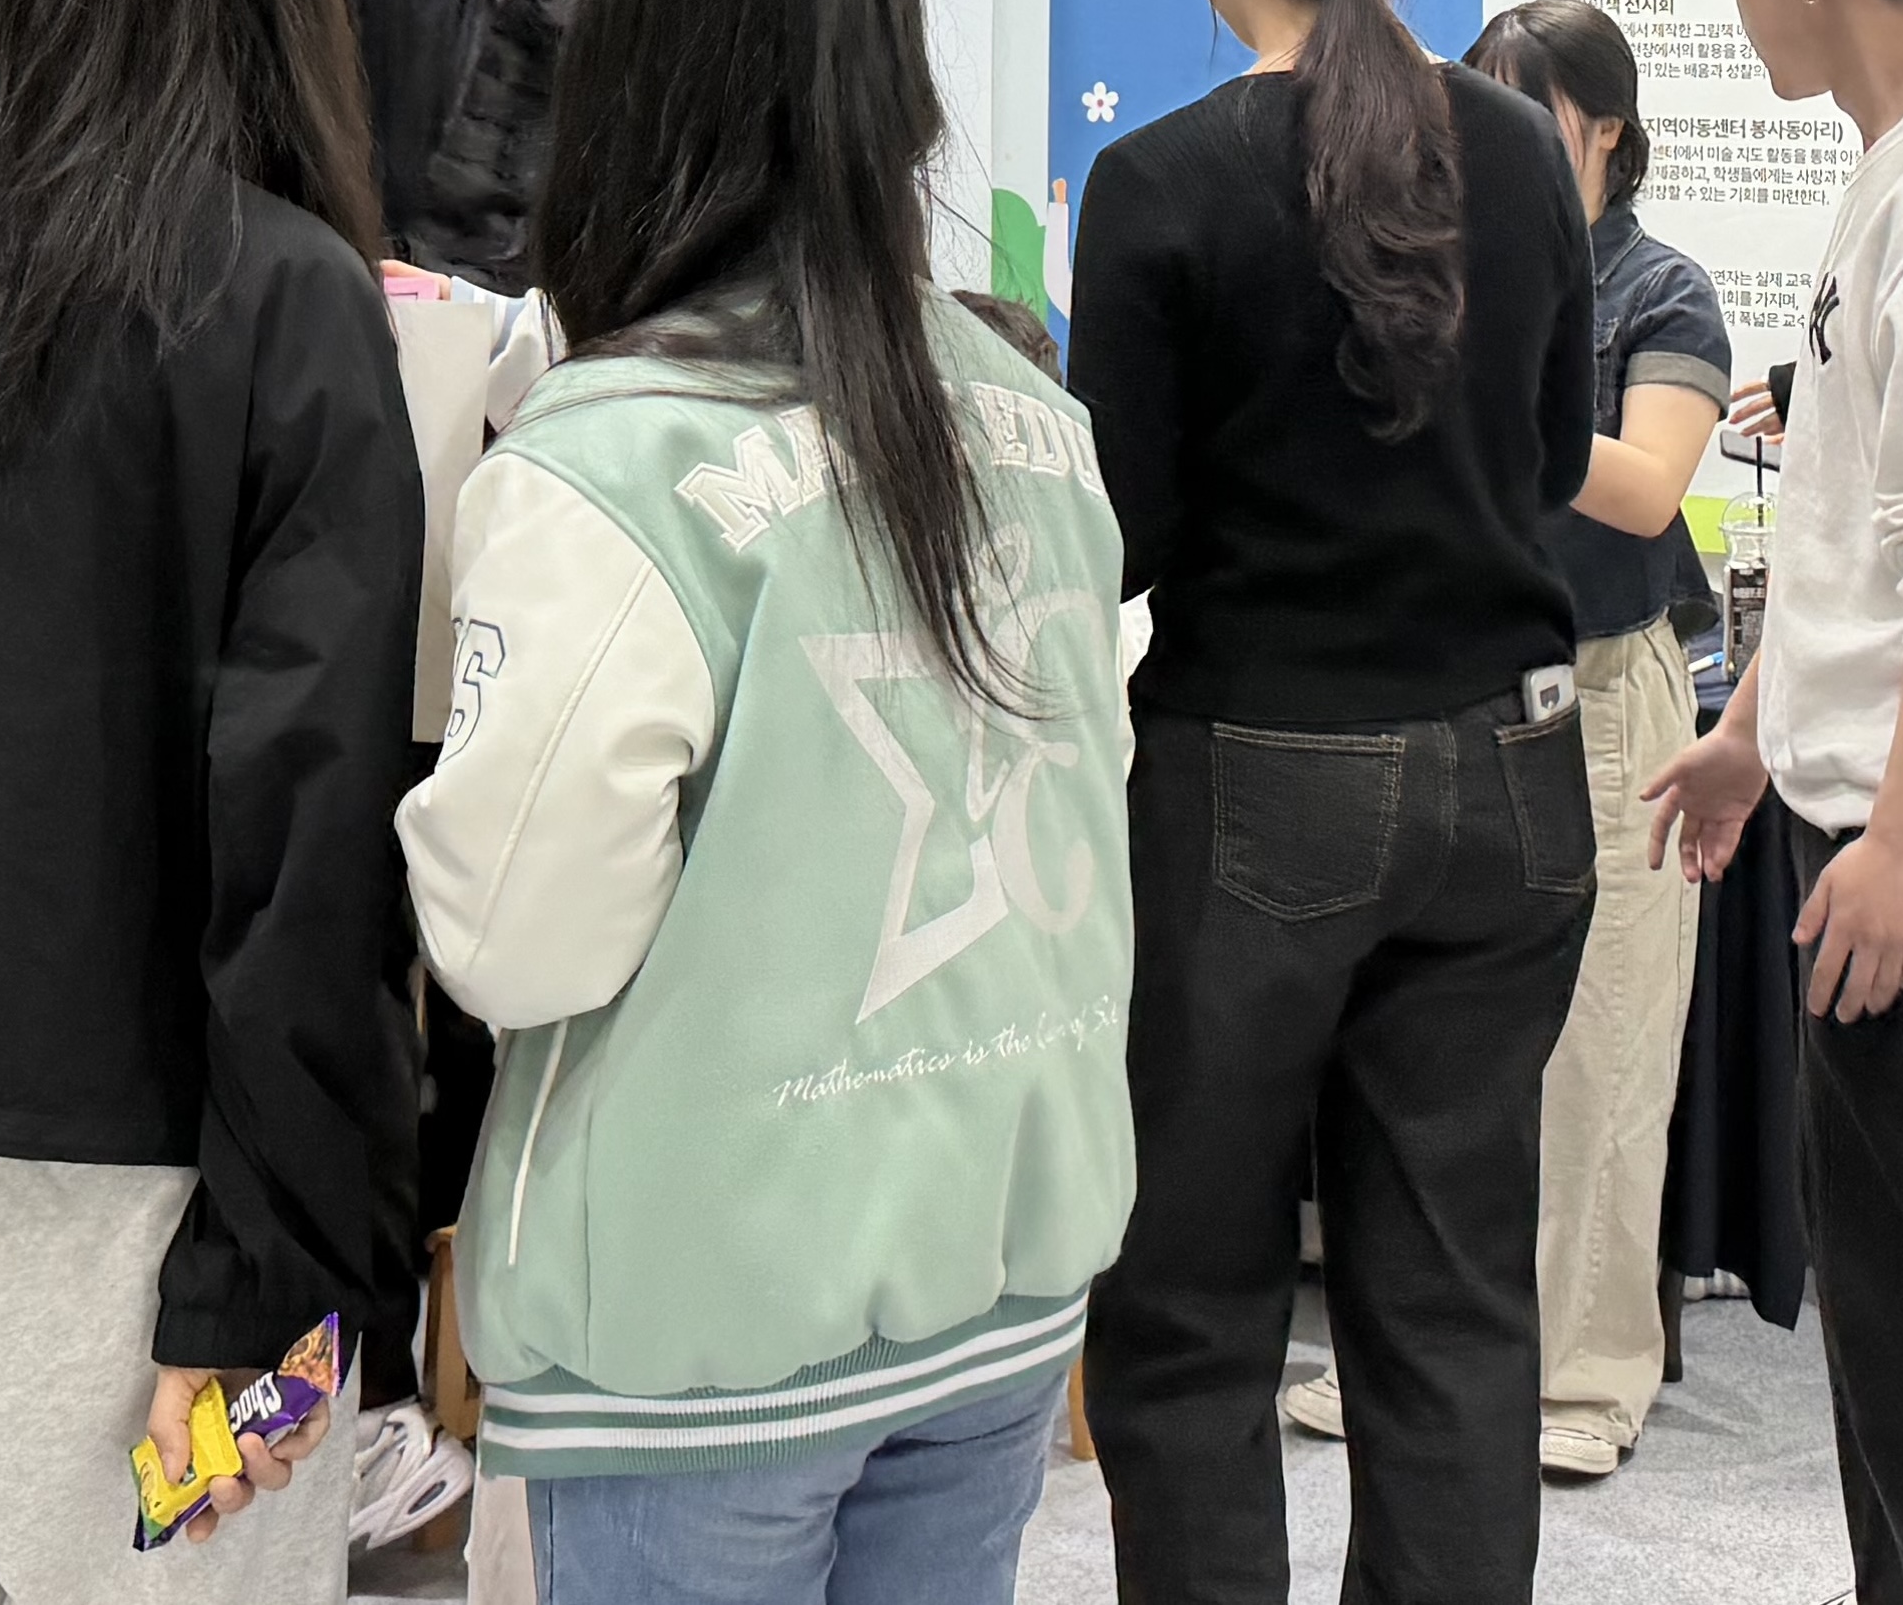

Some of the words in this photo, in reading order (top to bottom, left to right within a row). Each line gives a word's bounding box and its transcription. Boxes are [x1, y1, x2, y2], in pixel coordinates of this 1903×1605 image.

[1750, 119, 1844, 143] 봉사동아리)
[1714, 166, 1793, 185] 학생들에게는
[1773, 189, 1830, 206] 마련한다.
[772, 1047, 956, 1107] Mathematics
[962, 1040, 990, 1064] is
[992, 1023, 1031, 1057] the
